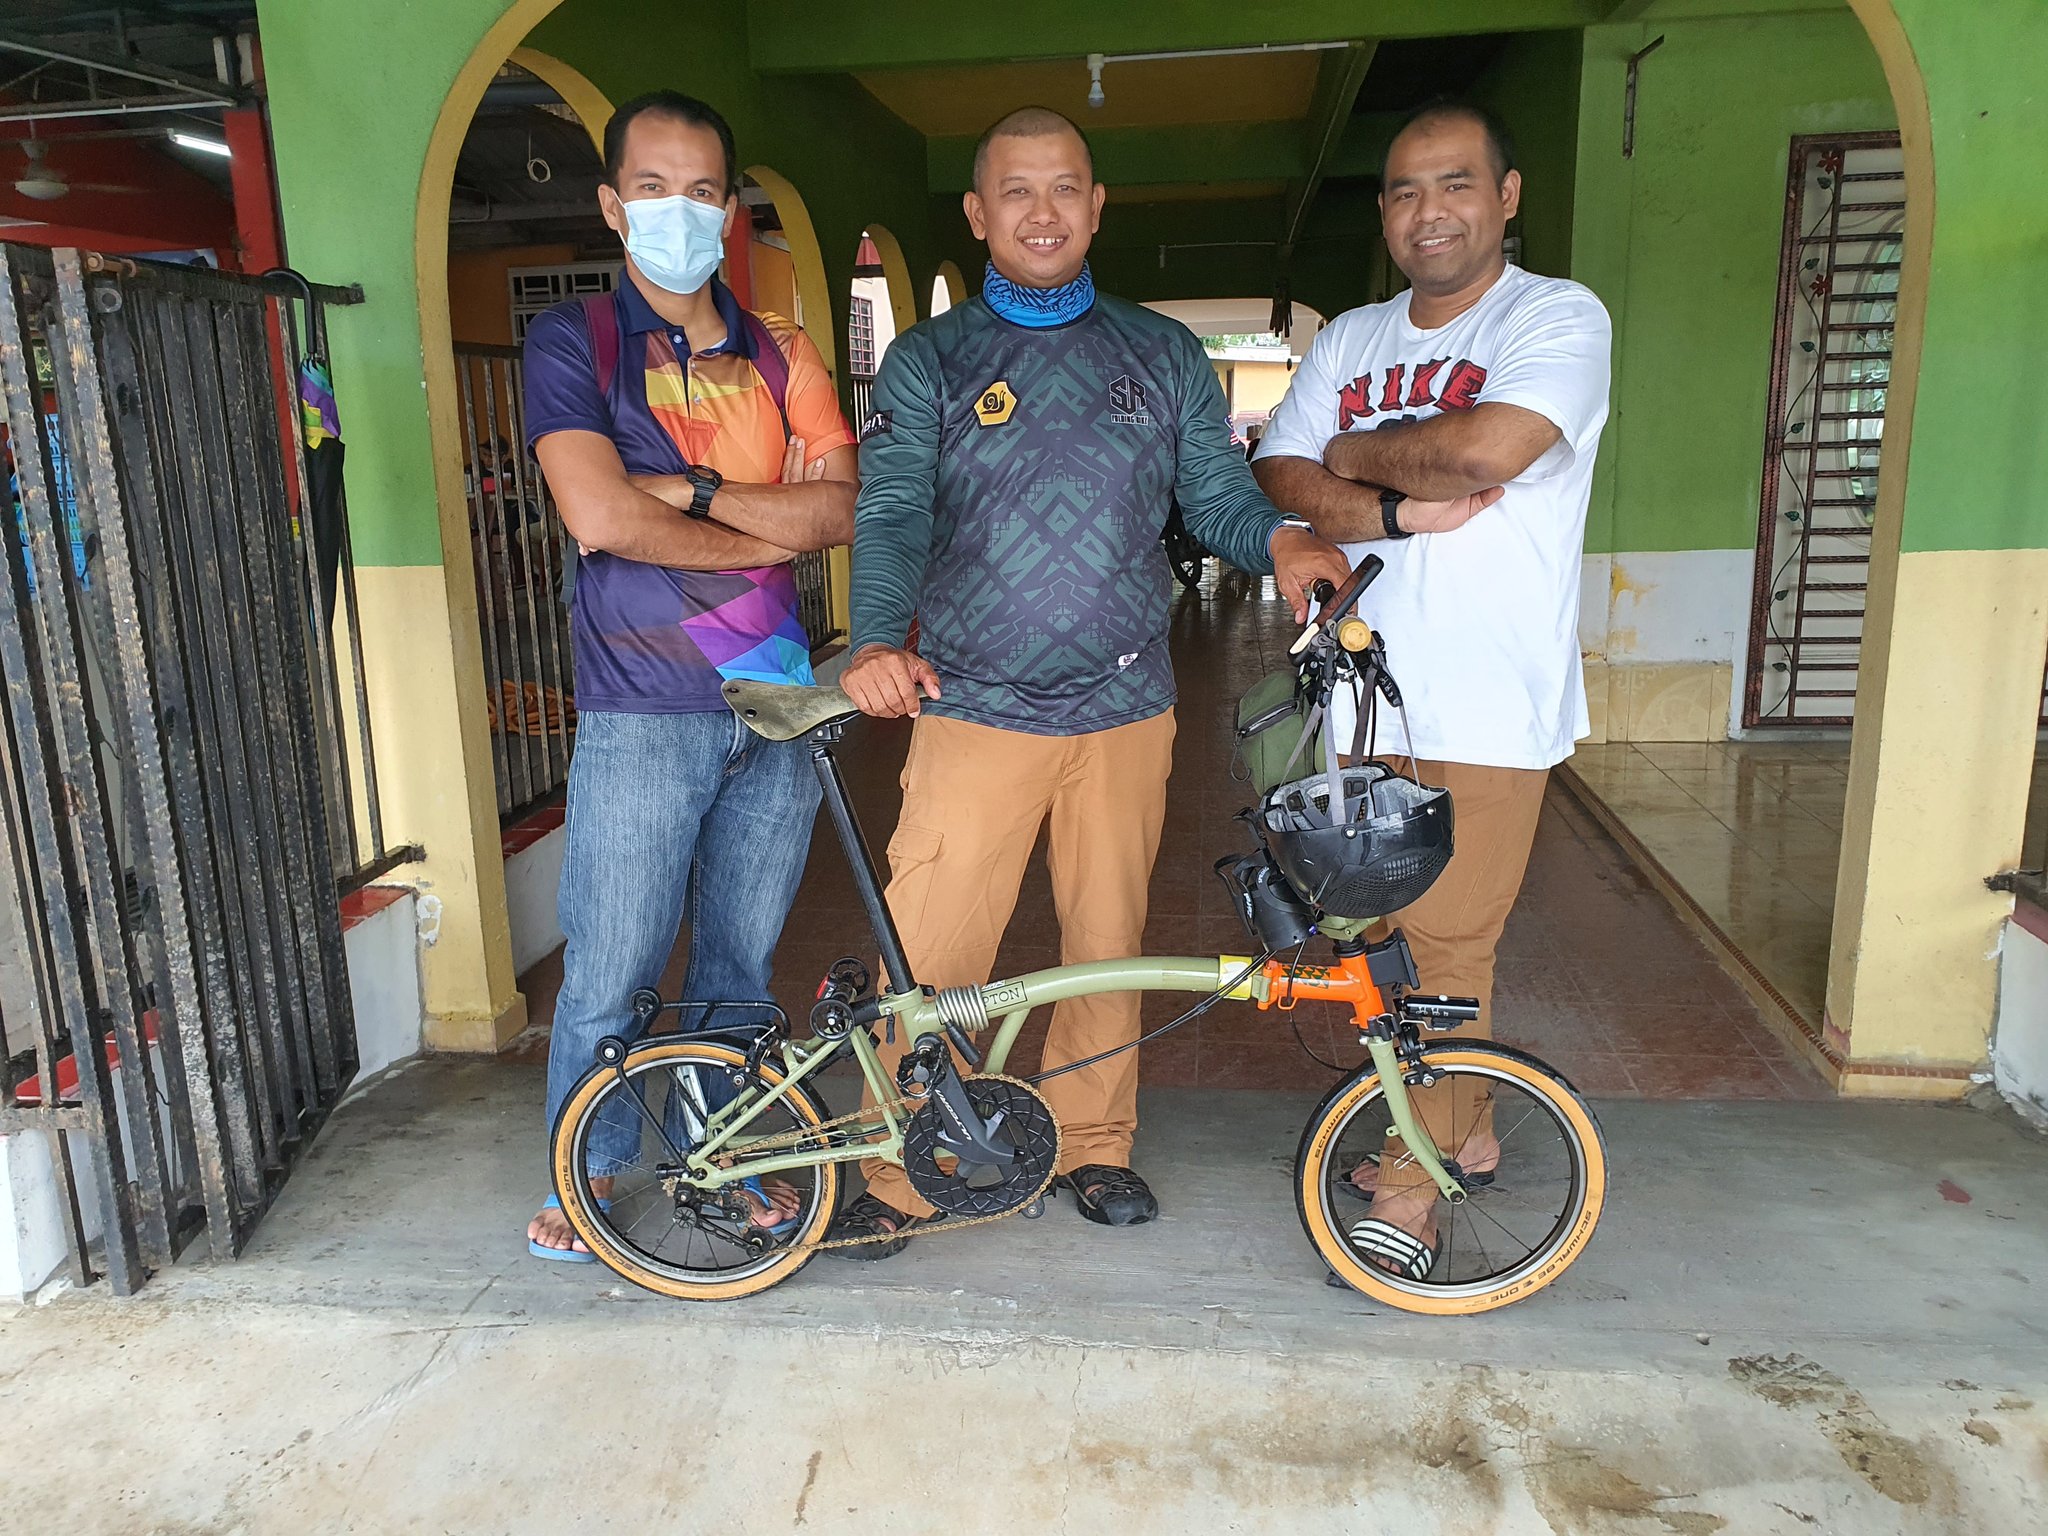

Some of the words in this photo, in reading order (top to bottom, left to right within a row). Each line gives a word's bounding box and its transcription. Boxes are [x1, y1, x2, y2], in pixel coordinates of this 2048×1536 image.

[1108, 374, 1148, 416] SR
[1337, 356, 1487, 430] NIKE
[983, 987, 1020, 1007] PTON
[1314, 1087, 1368, 1159] SCHWALBE
[1537, 1210, 1592, 1281] SCHWALBE
[1490, 1286, 1520, 1303] ONE
